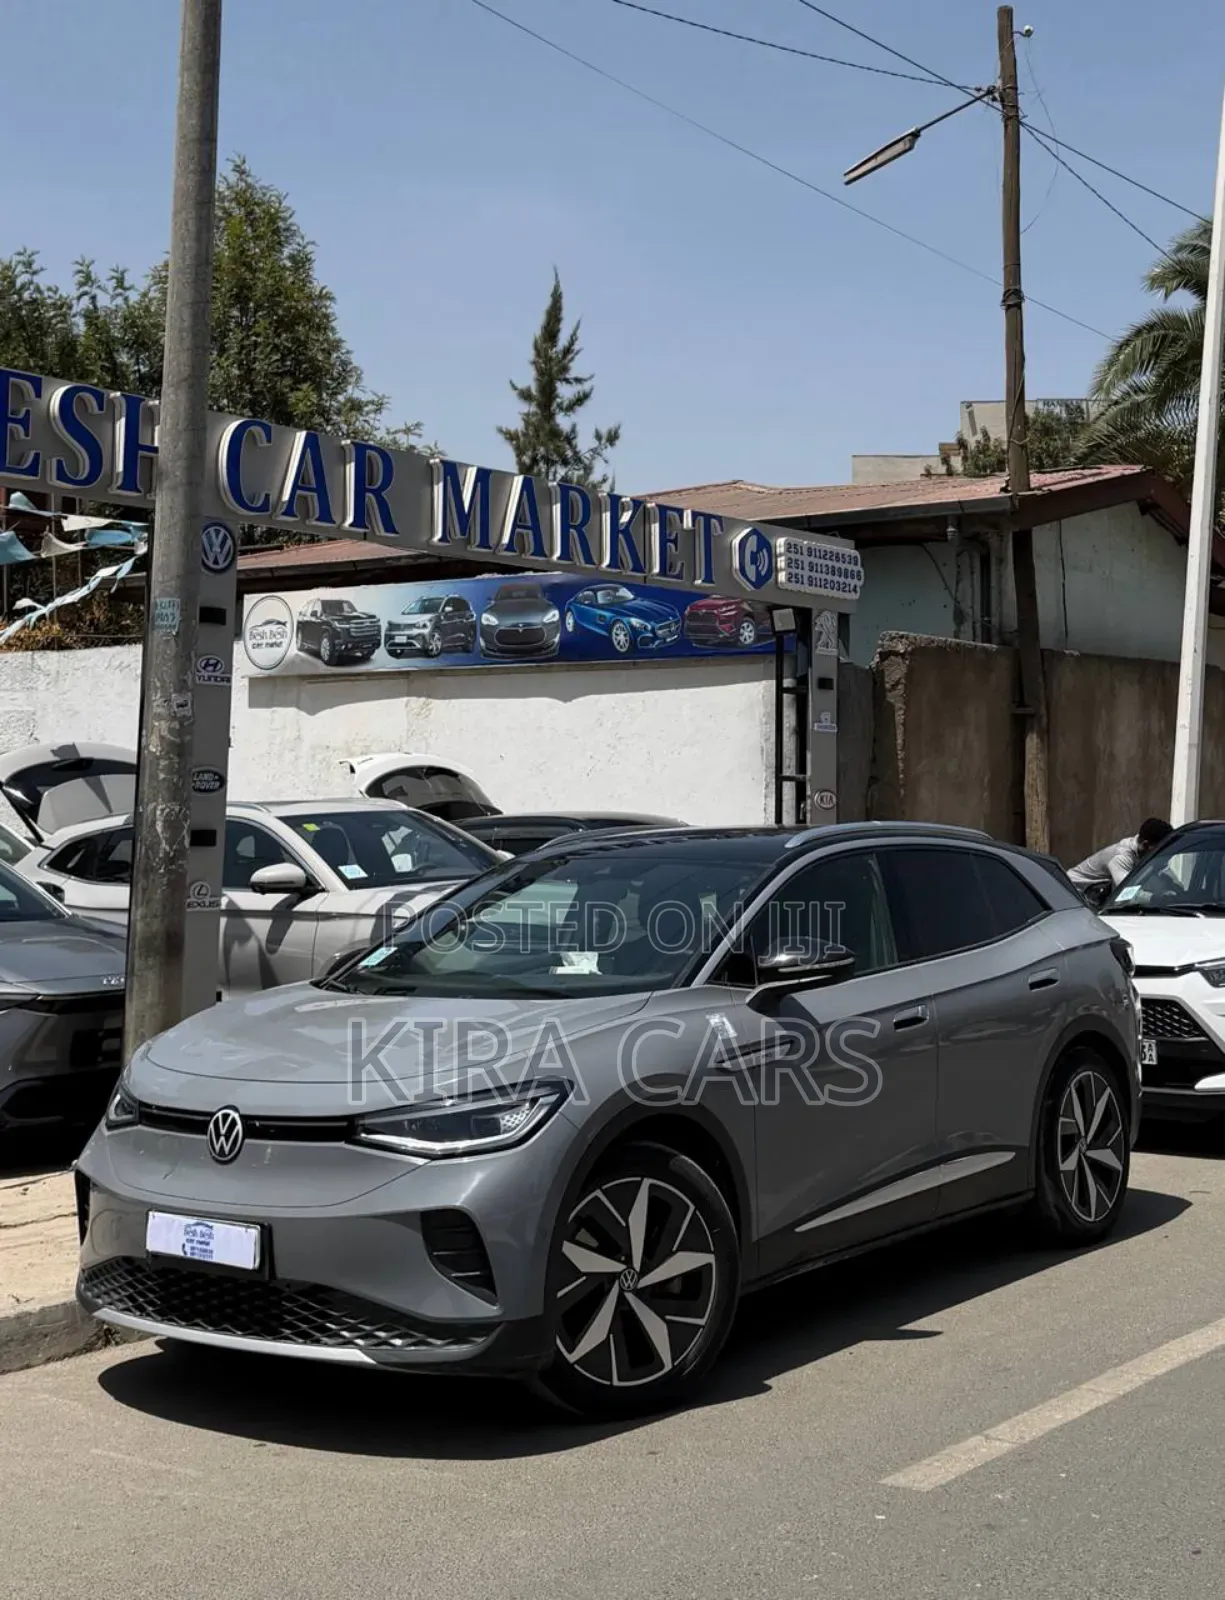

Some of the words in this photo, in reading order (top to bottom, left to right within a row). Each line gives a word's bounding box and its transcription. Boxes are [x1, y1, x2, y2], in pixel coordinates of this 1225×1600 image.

[219, 419, 400, 536] CAR
[430, 458, 724, 586] MARKET
[786, 542, 804, 556] 251
[787, 558, 805, 570] 251
[787, 572, 805, 584] 251
[808, 576, 858, 594] 911203214
